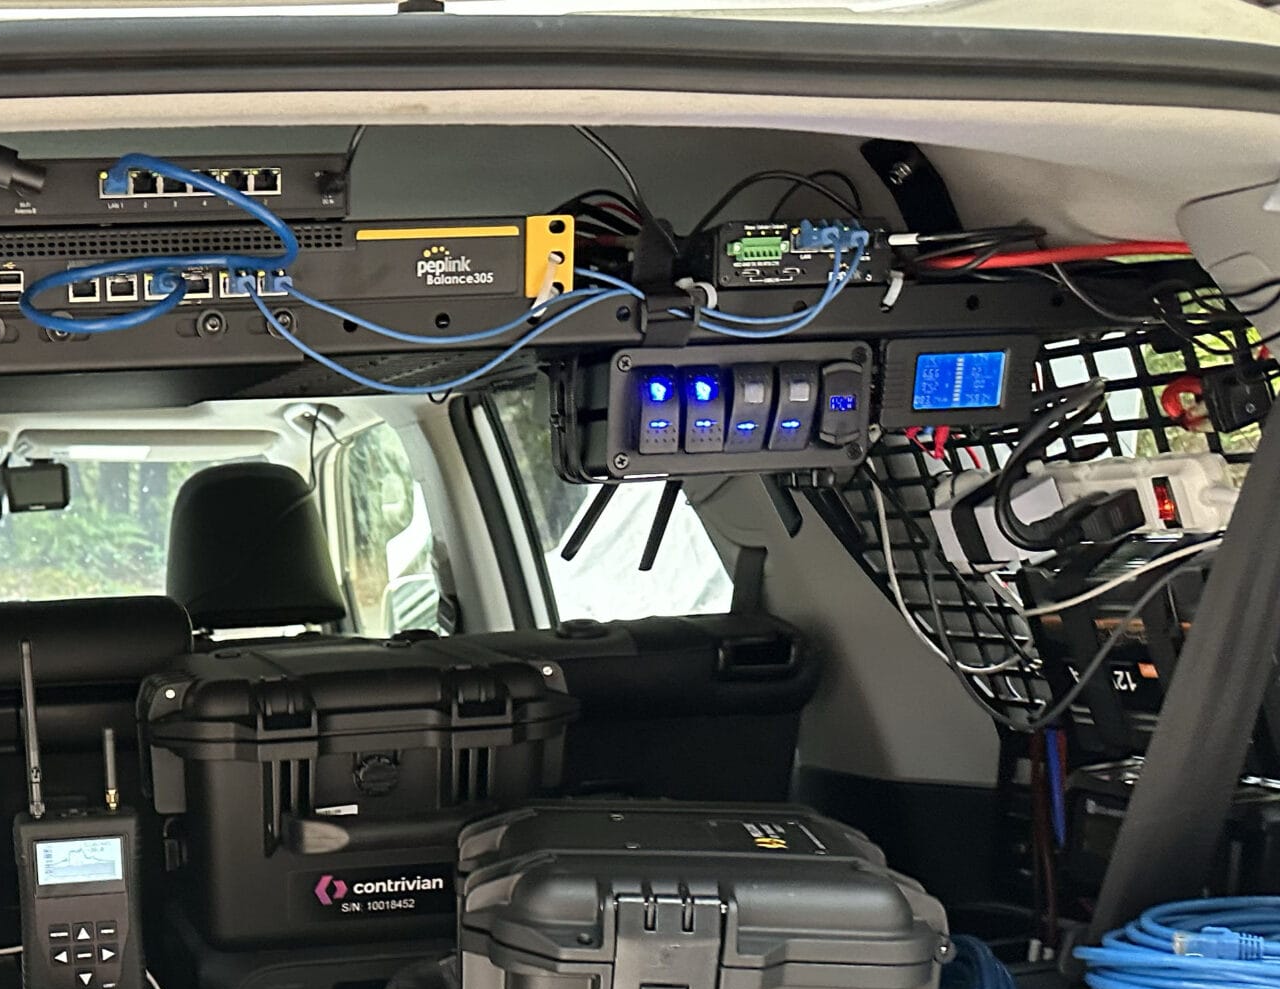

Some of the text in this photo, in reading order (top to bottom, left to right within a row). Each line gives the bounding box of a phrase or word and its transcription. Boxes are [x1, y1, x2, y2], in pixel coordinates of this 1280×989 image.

[416, 256, 471, 277] peplink
[352, 875, 444, 895] contrivian
[367, 899, 415, 911] 10018452
